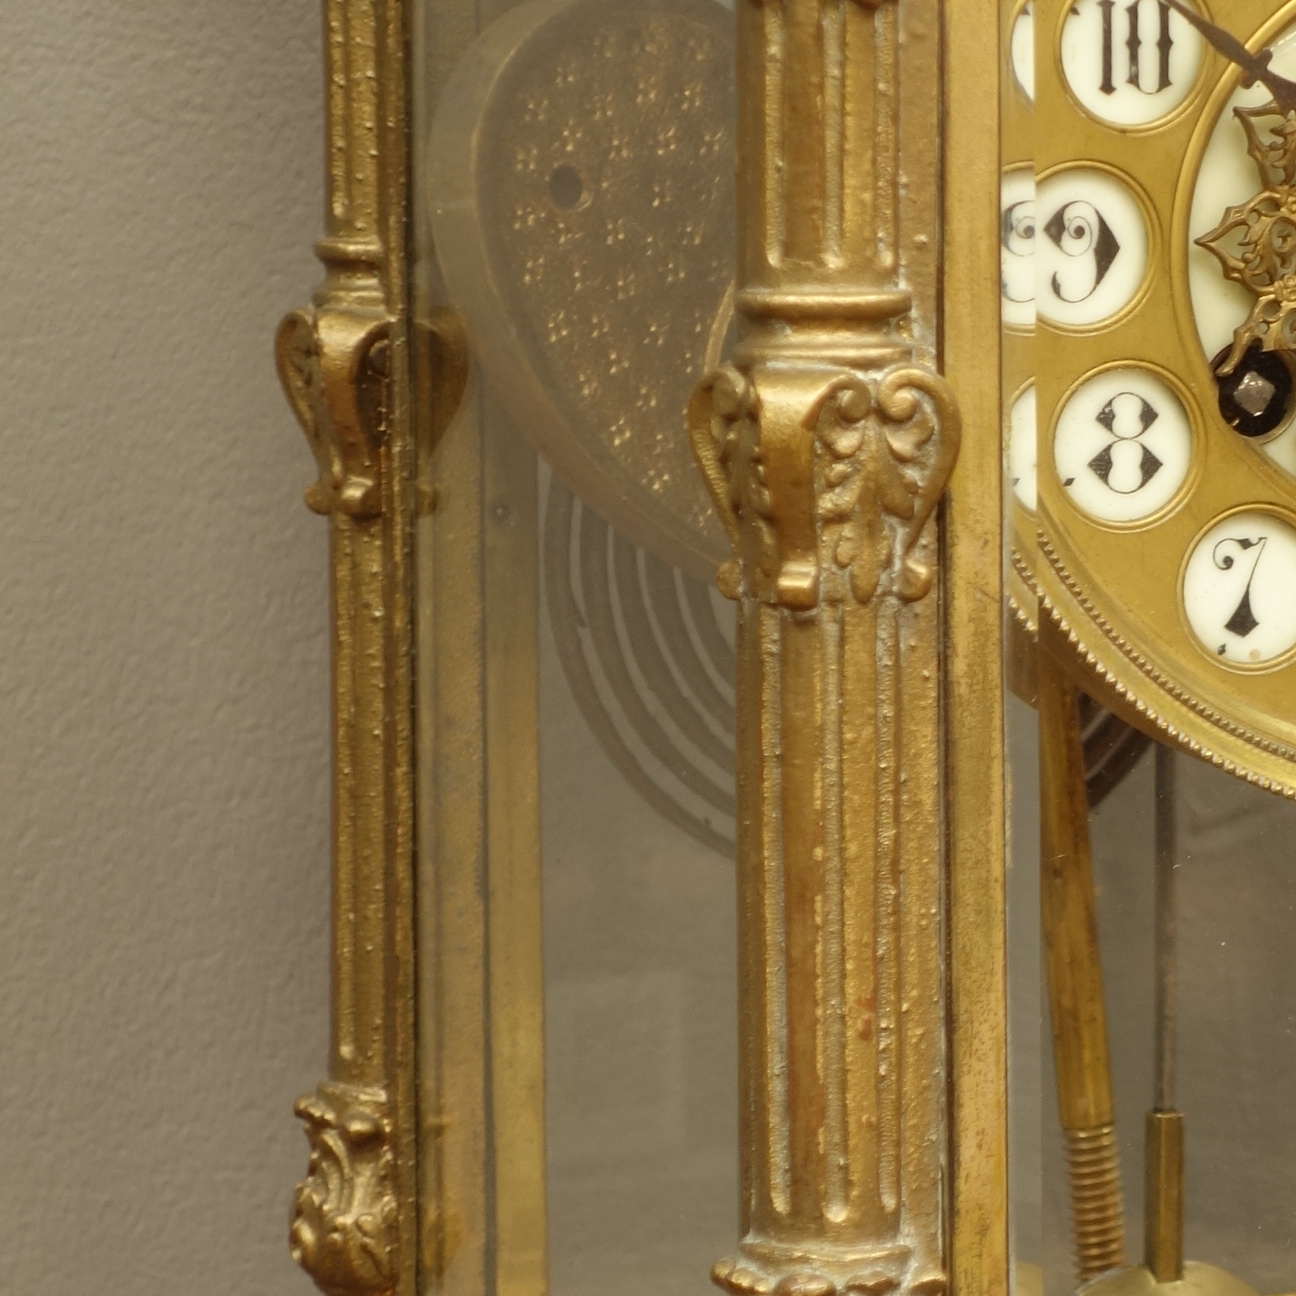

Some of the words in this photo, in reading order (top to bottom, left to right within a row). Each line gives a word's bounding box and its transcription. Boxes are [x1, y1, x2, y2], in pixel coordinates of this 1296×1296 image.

[1043, 199, 1121, 304] 9
[1087, 391, 1164, 495] 8
[1212, 536, 1268, 638] 7
